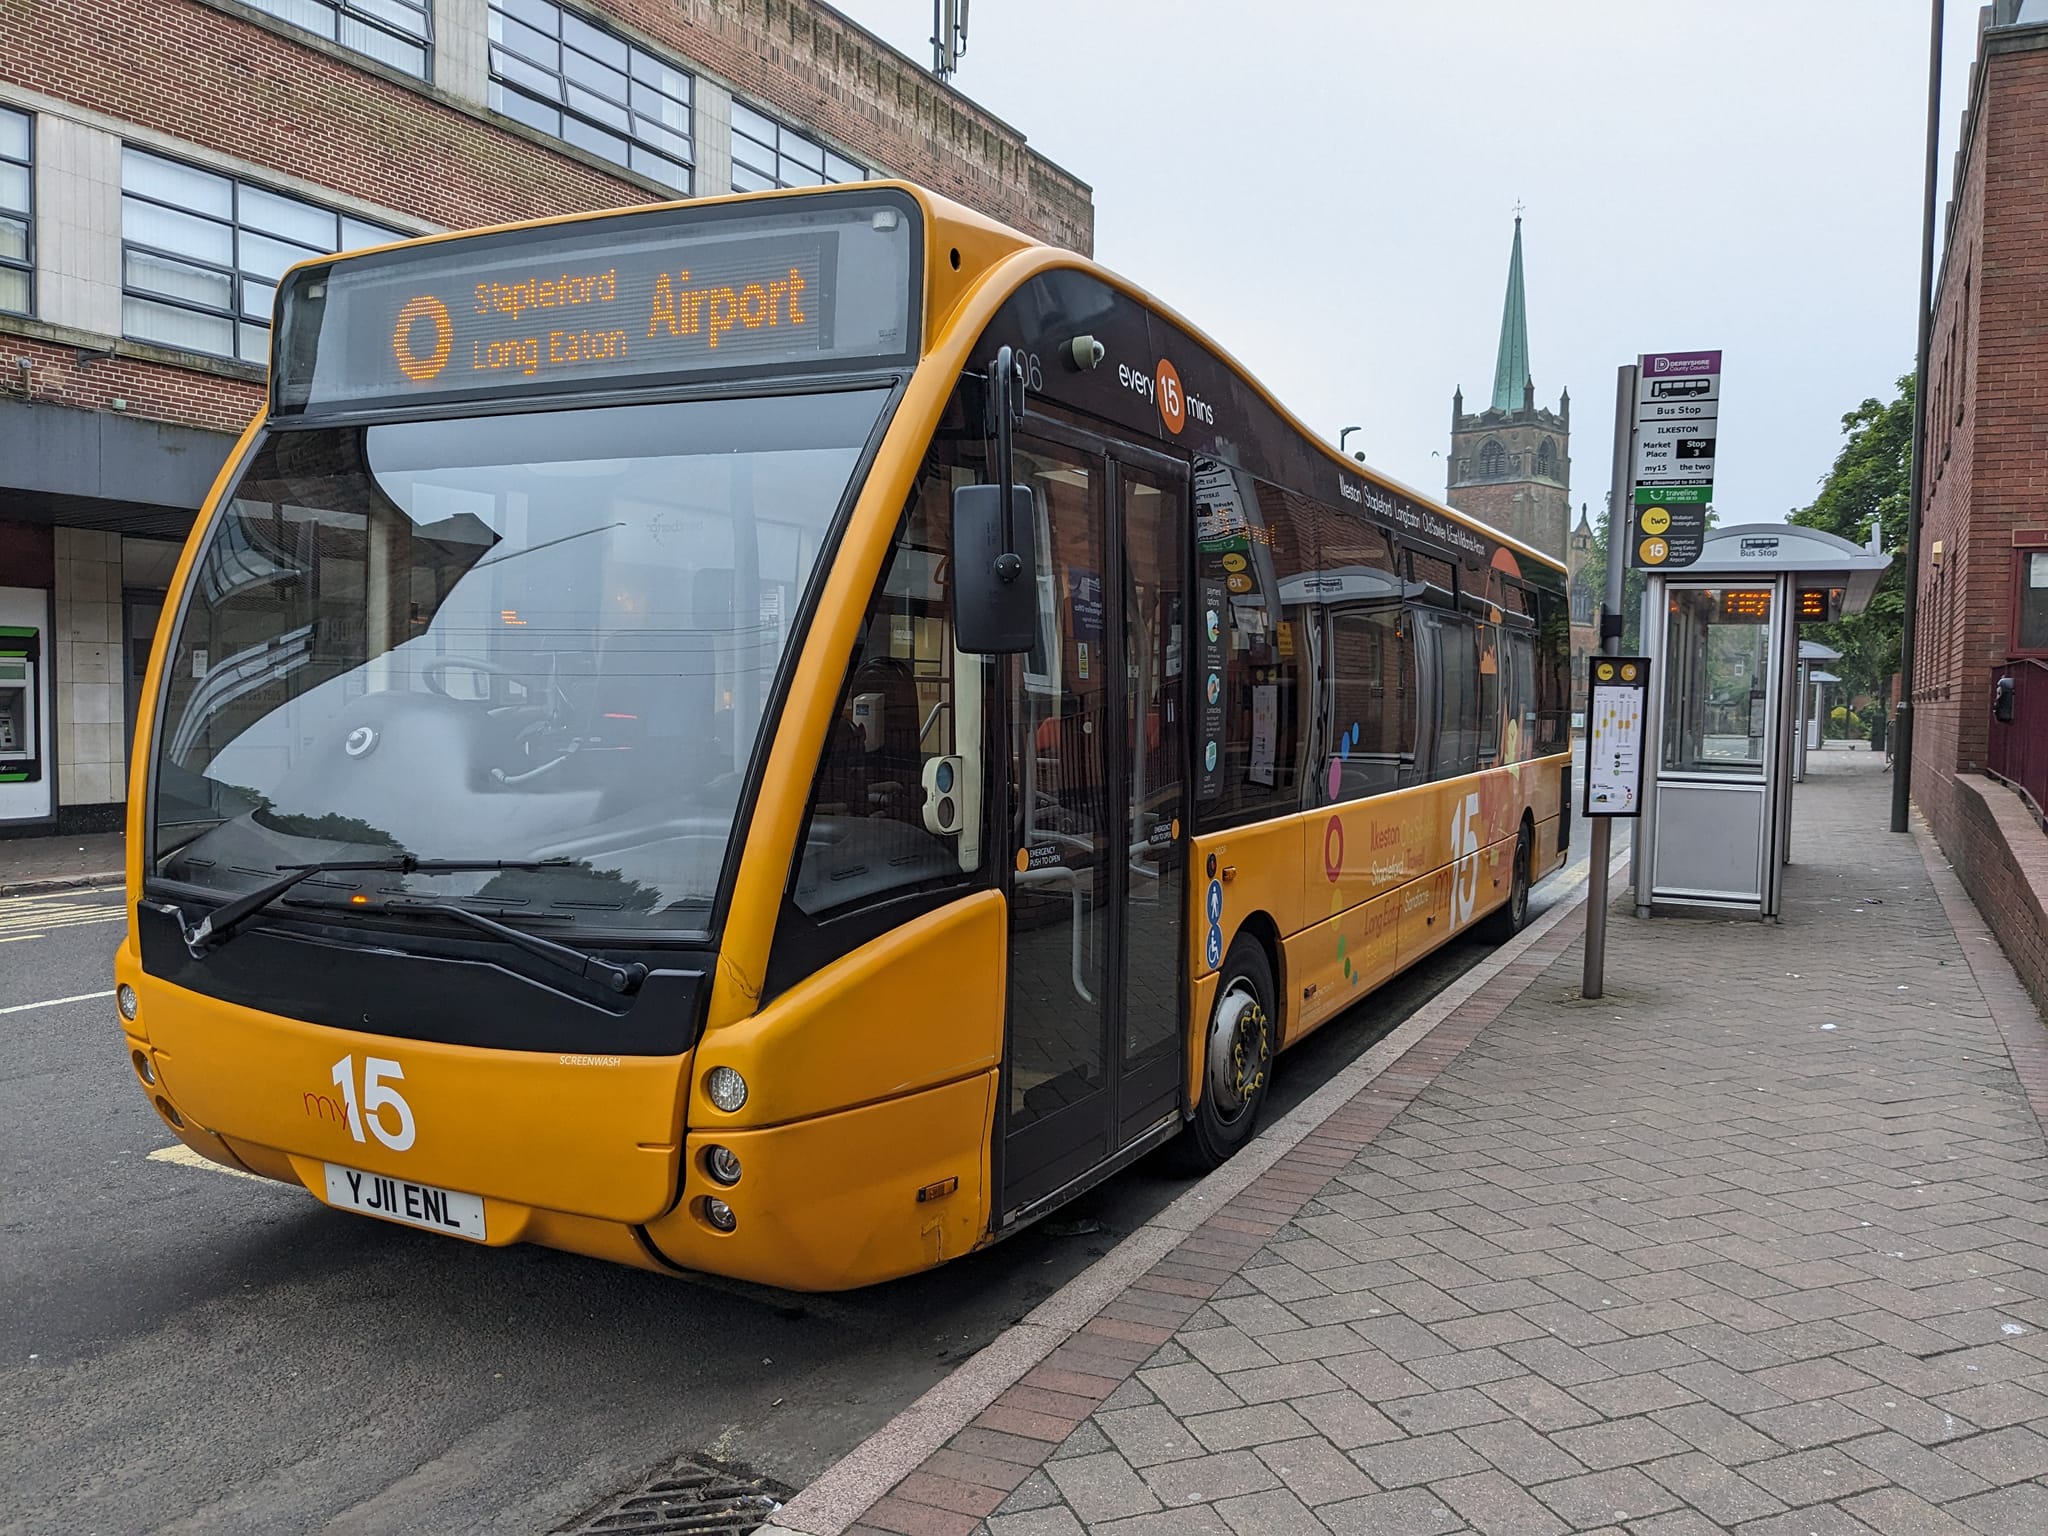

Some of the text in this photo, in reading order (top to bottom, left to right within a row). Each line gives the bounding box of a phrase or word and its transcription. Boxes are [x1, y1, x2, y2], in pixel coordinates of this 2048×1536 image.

[474, 268, 616, 320] Stapleford
[648, 267, 807, 348] Airport
[473, 329, 627, 375] Long Eaton
[1119, 363, 1214, 425] every 15 mins
[1657, 406, 1702, 415] Bus Stop
[1657, 426, 1699, 434] ILKESTON
[1643, 441, 1671, 449] Market
[1687, 440, 1706, 449] Stop
[1692, 449, 1700, 457] 3
[1644, 464, 1667, 472] my15
[1679, 463, 1711, 471] the two
[1666, 489, 1698, 497] traveline
[1651, 516, 1668, 525] two
[1649, 543, 1664, 557] 15
[1758, 549, 1778, 558] Stop
[1371, 820, 1400, 852] Ilkeston
[1029, 846, 1056, 858] EMERGENCY
[1029, 854, 1061, 867] PUSH TO OPEN
[1449, 792, 1480, 933] 15
[1371, 848, 1404, 888] Stapleford
[559, 1055, 621, 1067] SCREENWASH
[403, 1184, 460, 1228] ENL
